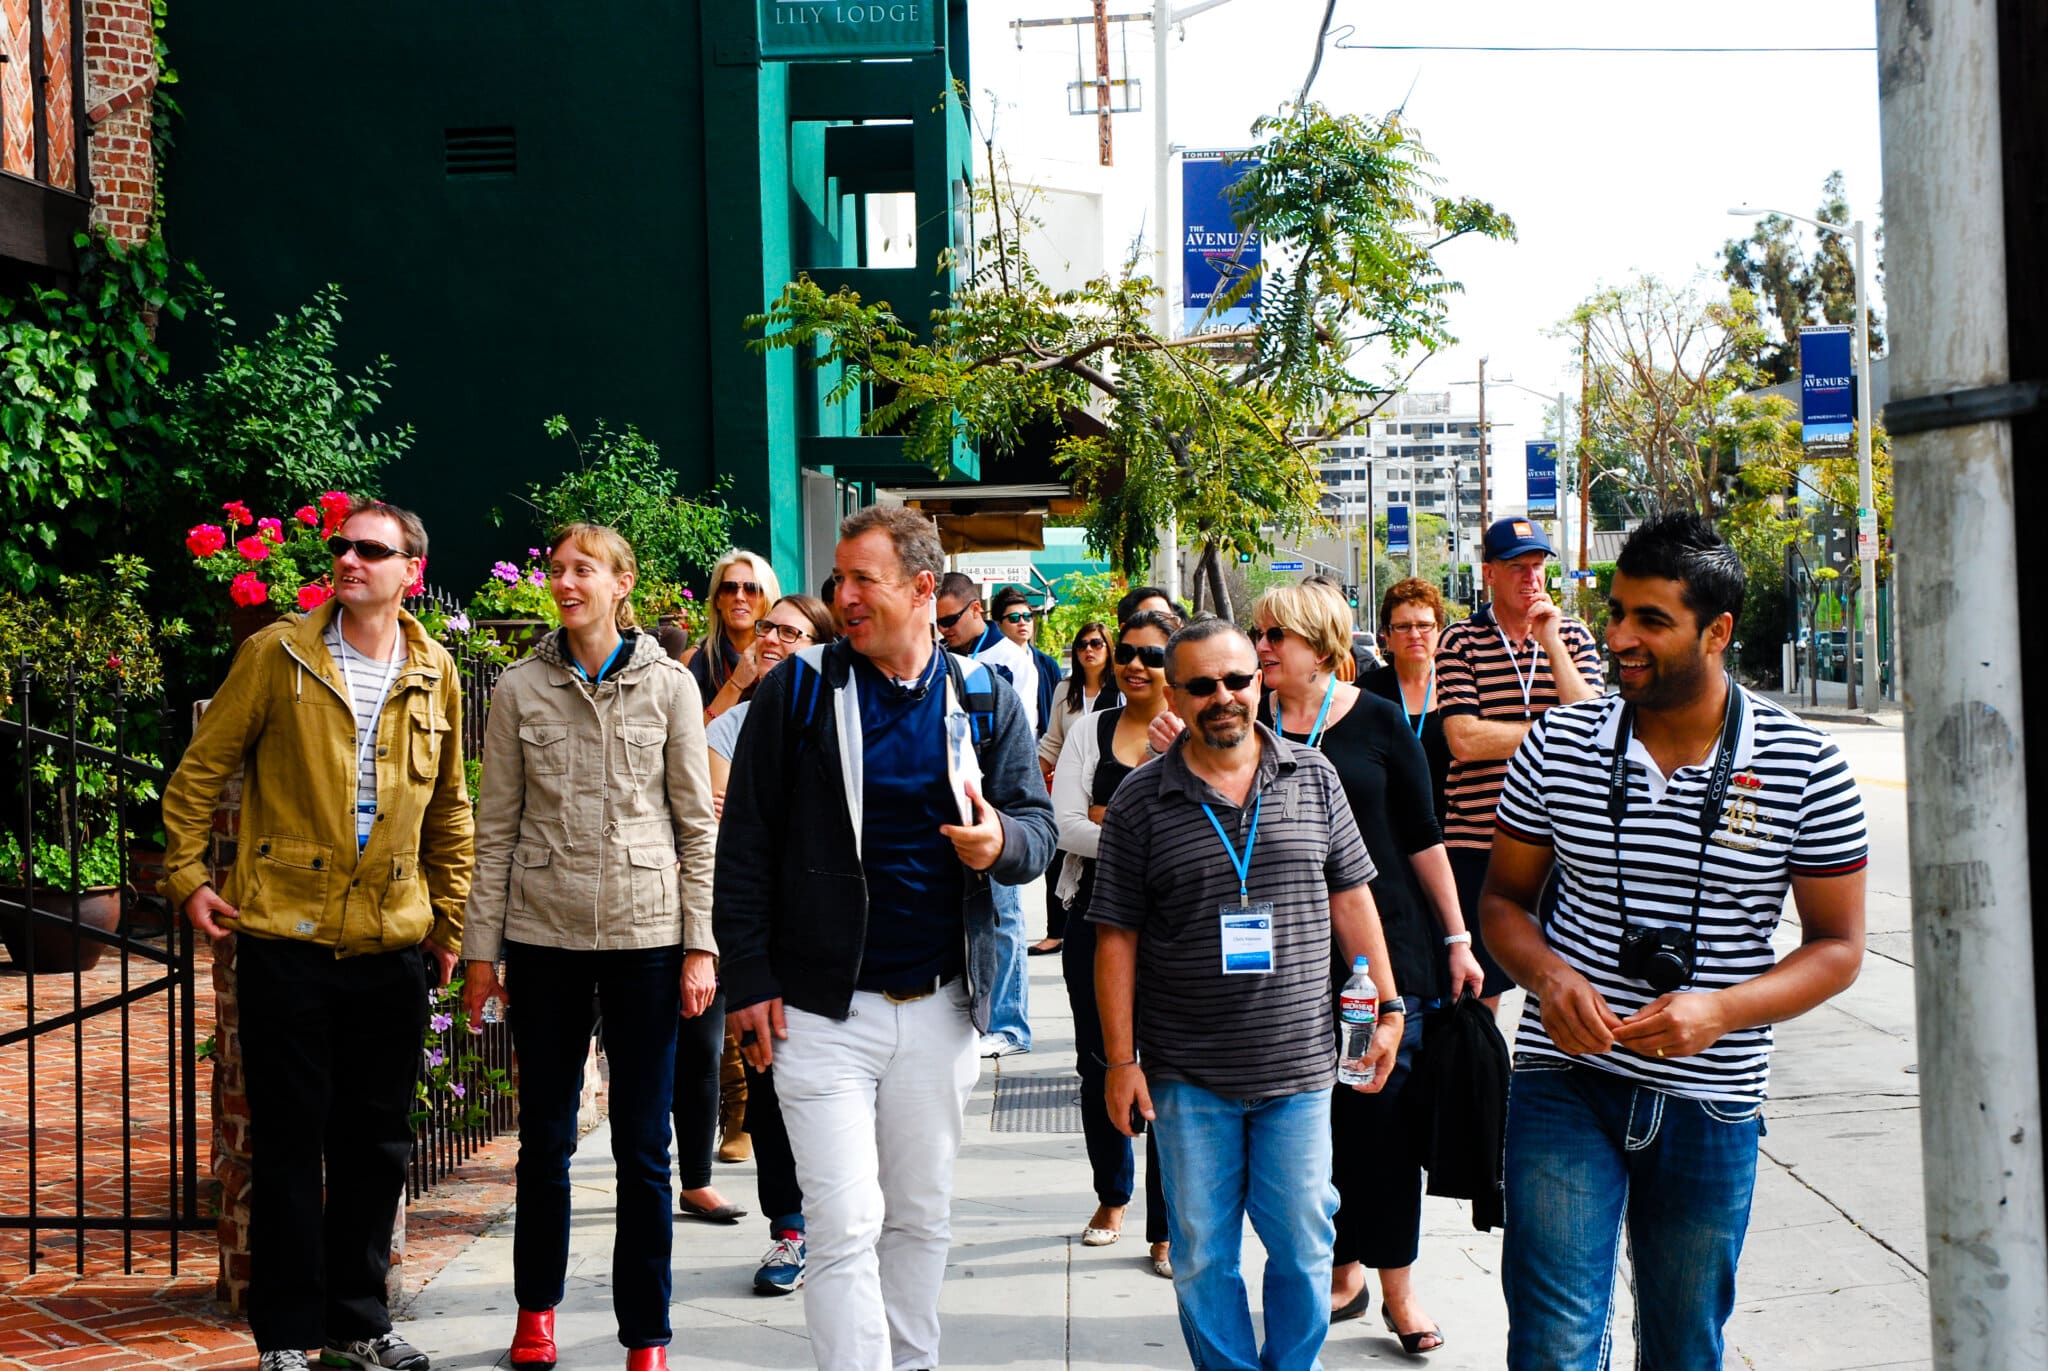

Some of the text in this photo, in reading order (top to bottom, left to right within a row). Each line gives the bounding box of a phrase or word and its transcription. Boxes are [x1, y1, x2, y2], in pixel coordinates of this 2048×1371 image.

[776, 4, 919, 25] LILY LODGE
[1188, 225, 1205, 233] THE
[1803, 377, 1850, 388] AVENUES
[1614, 754, 1624, 787] Nikon
[1711, 748, 1731, 800] COOLPIX
